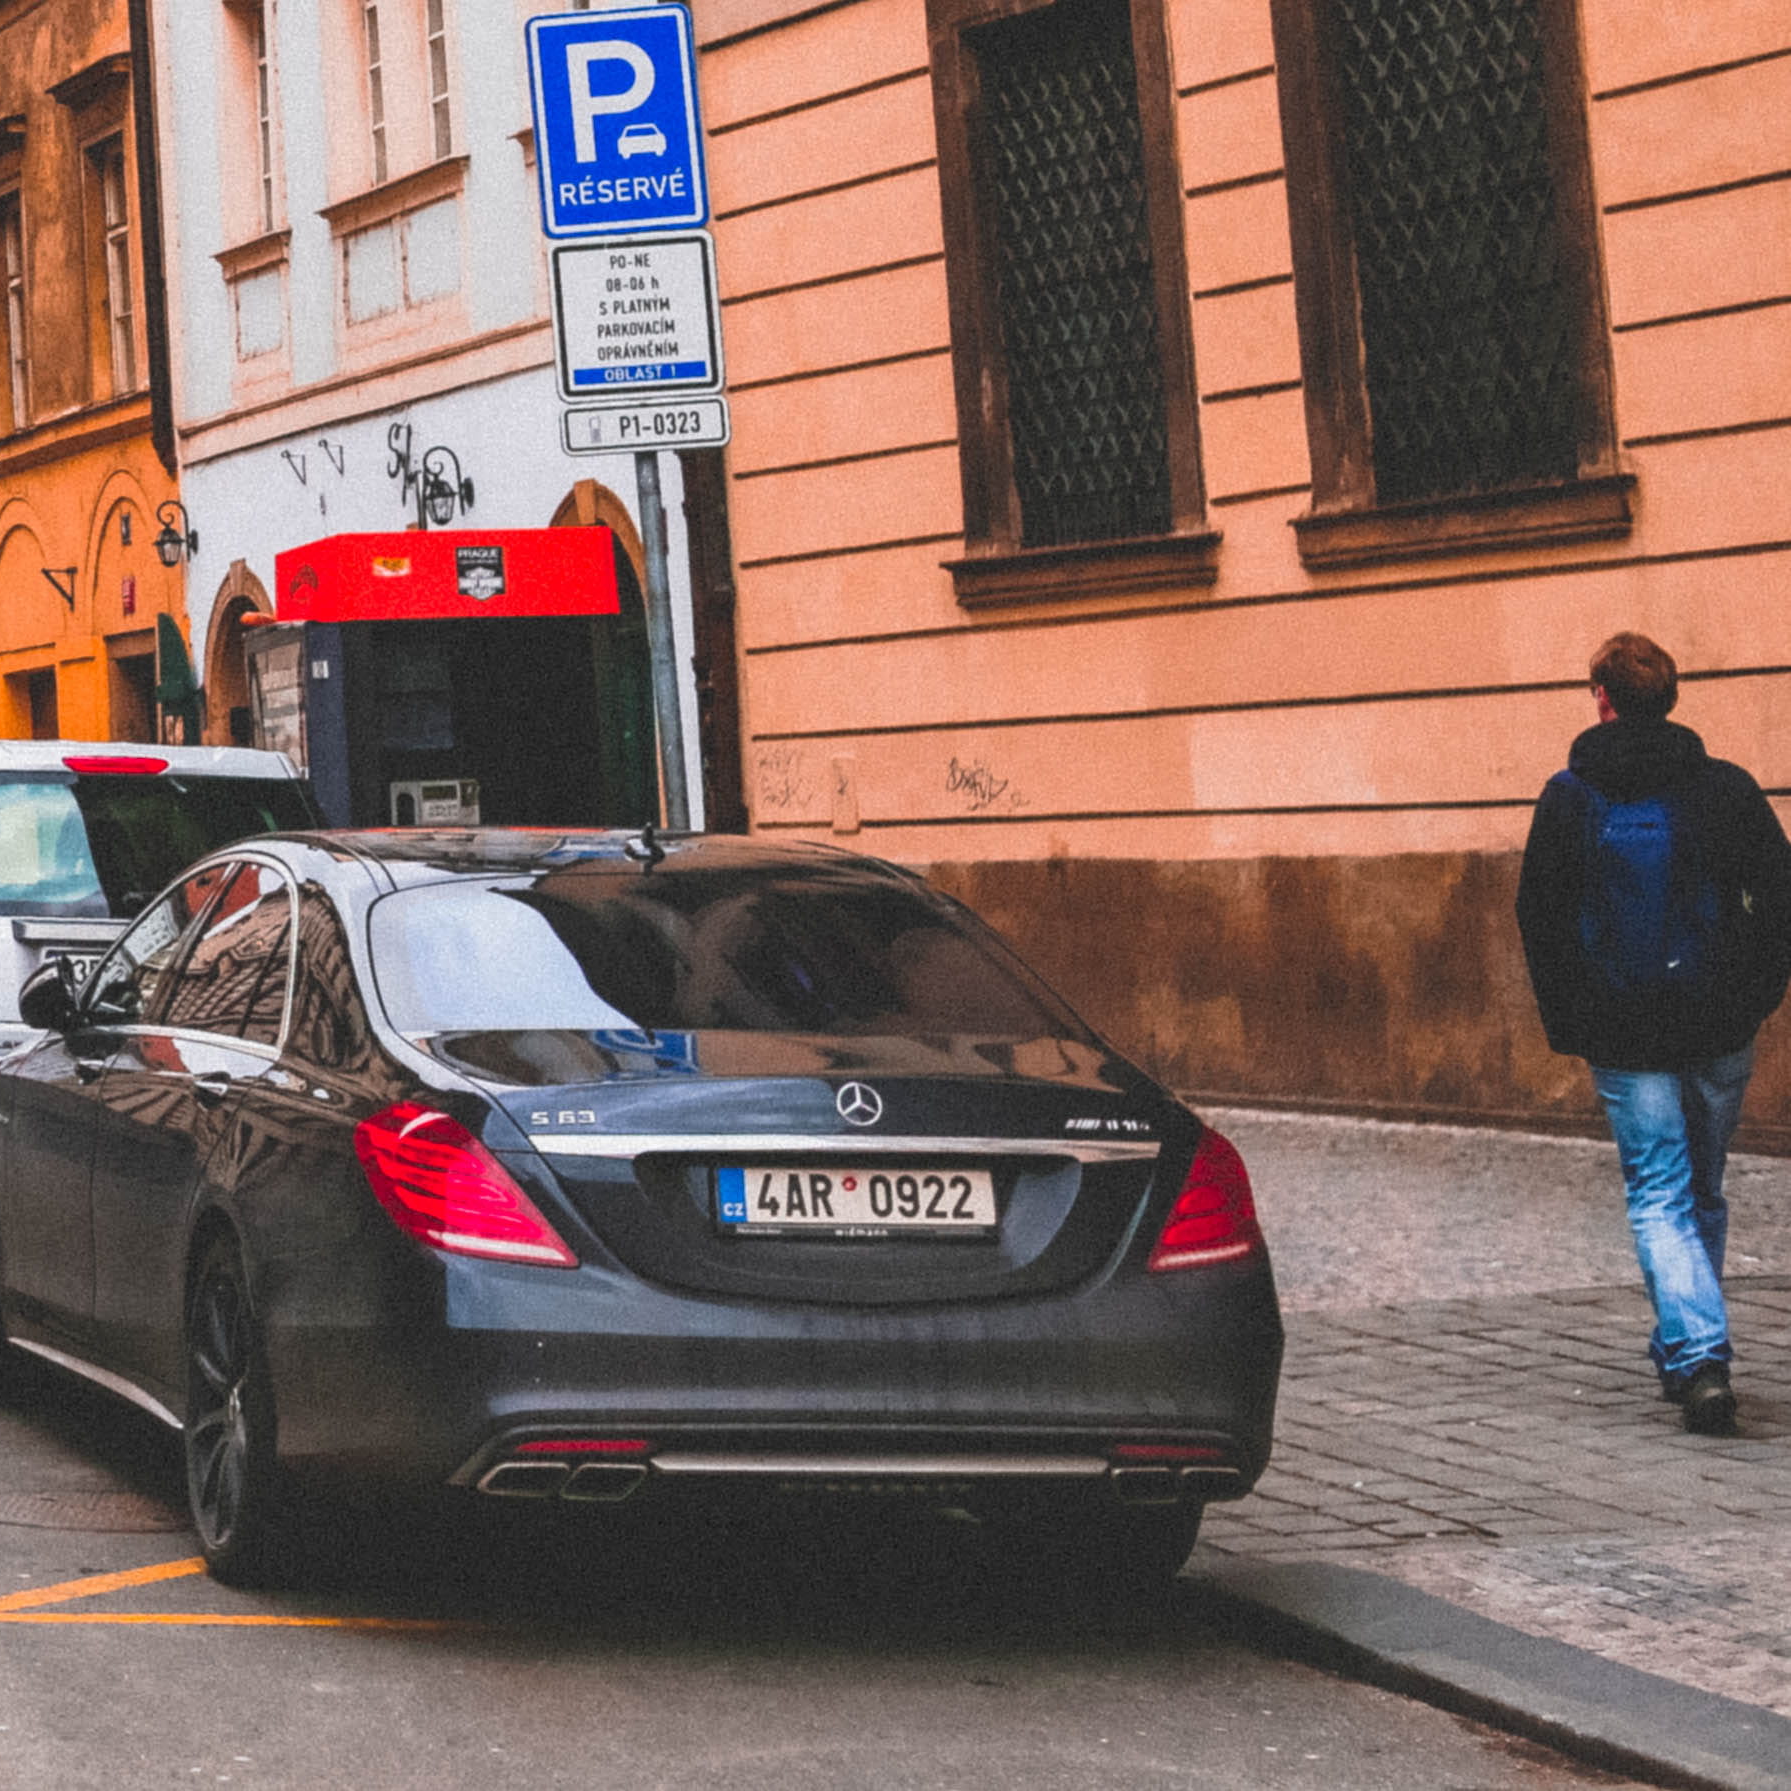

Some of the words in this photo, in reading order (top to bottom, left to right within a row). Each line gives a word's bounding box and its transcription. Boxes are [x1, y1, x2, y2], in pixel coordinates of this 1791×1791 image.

[566, 39, 656, 163] P
[559, 167, 686, 207] RÉSERVÉ
[610, 253, 651, 270] PO-NE
[606, 277, 646, 292] 08-06
[651, 276, 660, 290] h
[599, 301, 608, 316] S
[613, 295, 671, 315] PLATNÝM
[597, 319, 676, 339] PARKOVACÍM
[598, 340, 679, 361] OPRÁVNĚNÍM
[604, 366, 663, 382] OBLAST
[619, 411, 701, 438] P1-0323
[531, 1111, 549, 1125] S
[558, 1110, 596, 1124] 63
[723, 1202, 744, 1217] CZ
[757, 1173, 835, 1218] 4AR
[868, 1174, 975, 1219] 0922
